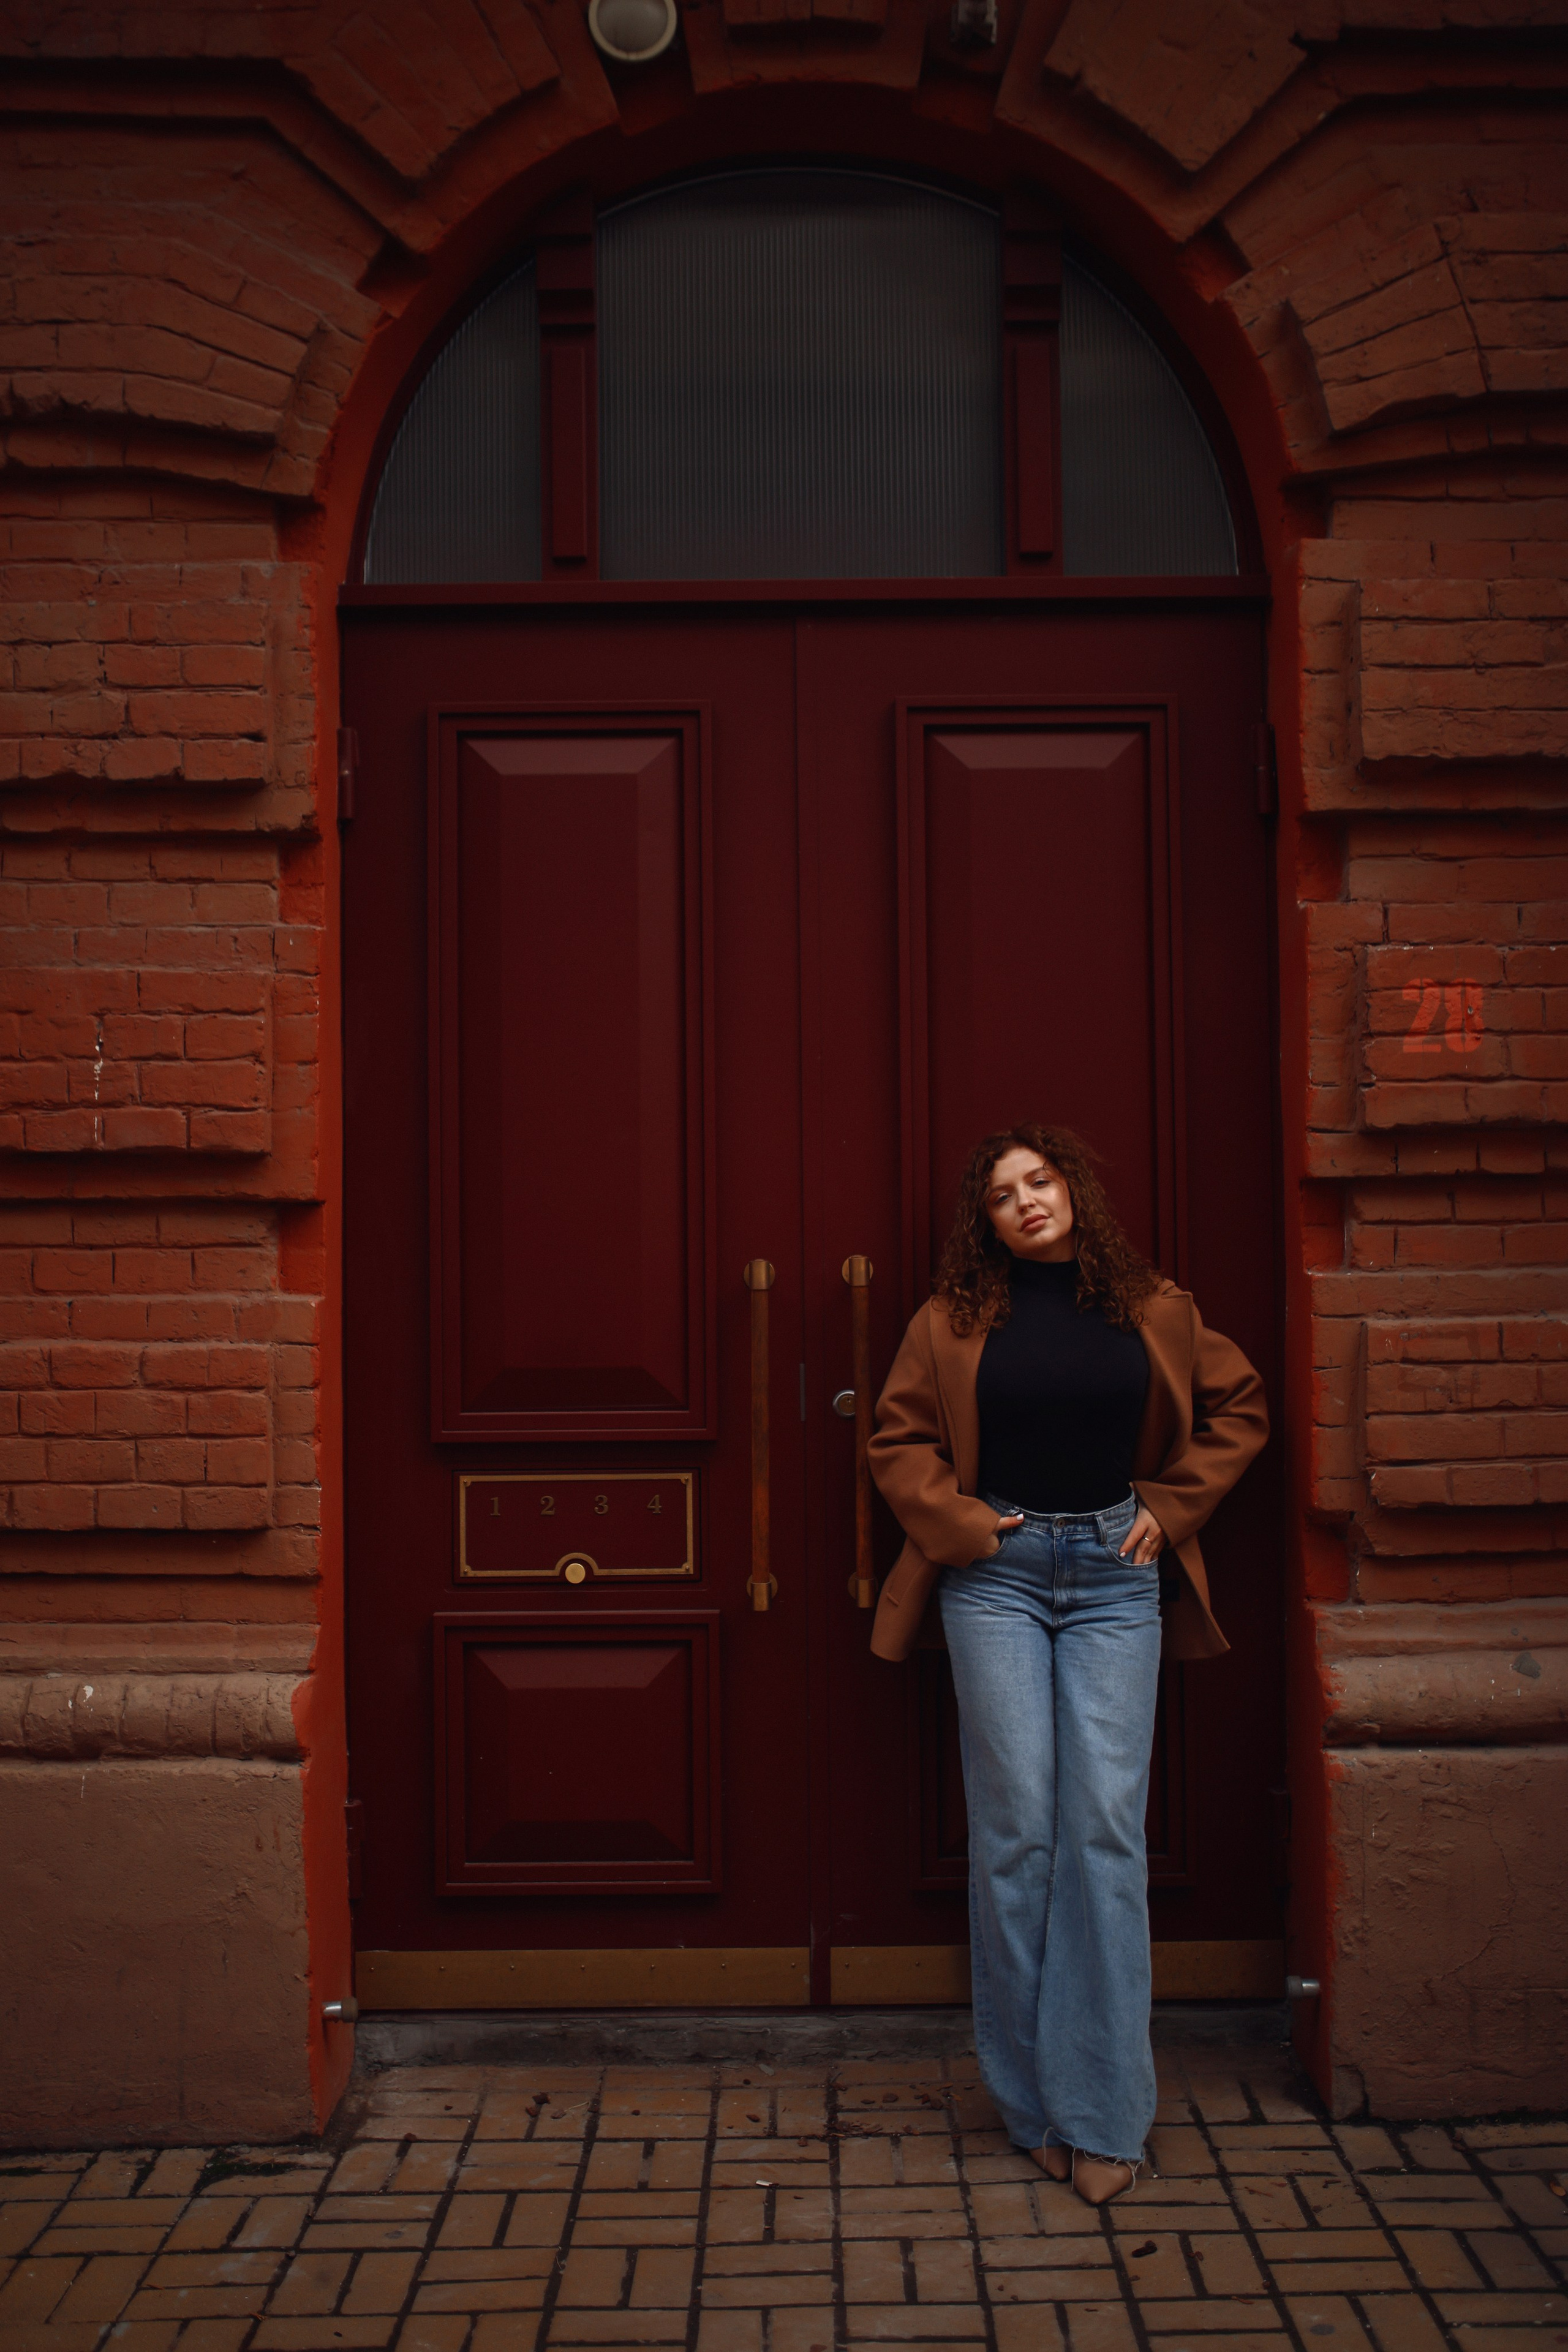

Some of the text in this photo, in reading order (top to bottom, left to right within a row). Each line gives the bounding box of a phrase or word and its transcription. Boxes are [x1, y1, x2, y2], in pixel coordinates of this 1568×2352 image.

[1402, 978, 1484, 1052] 28
[490, 1494, 662, 1516] 1 2 3 4
